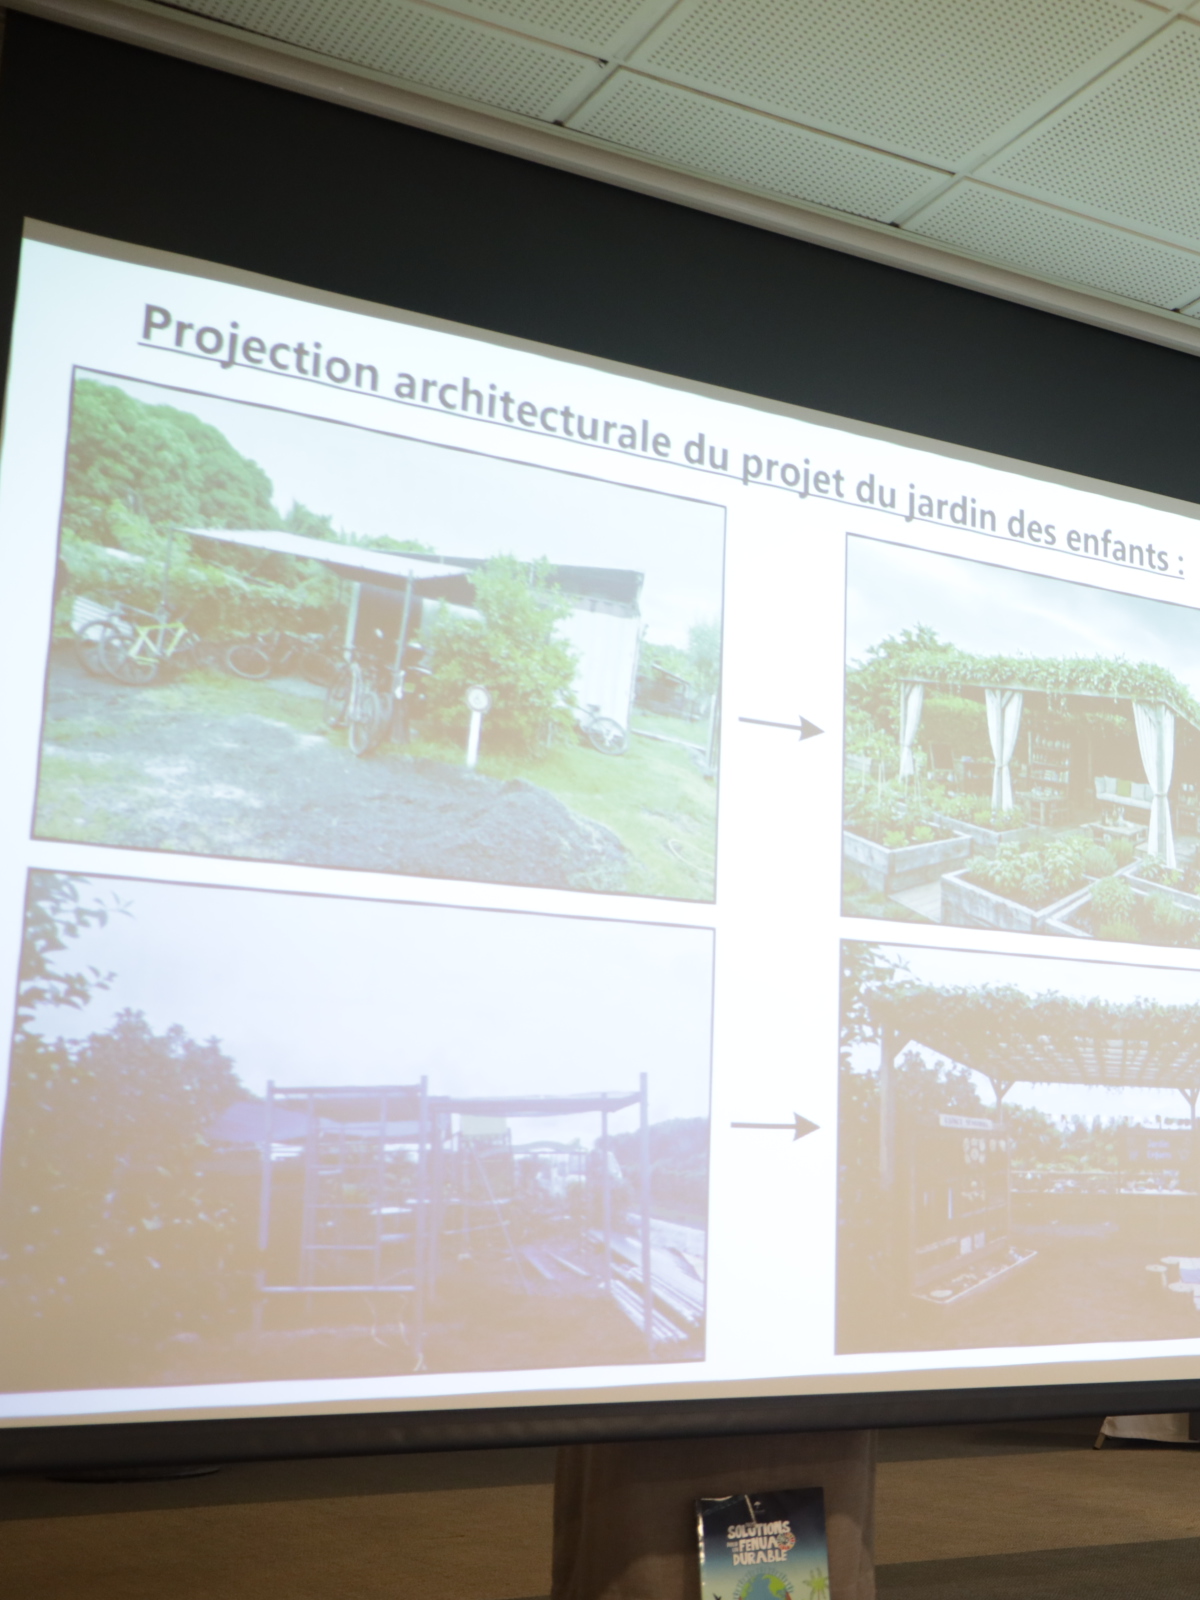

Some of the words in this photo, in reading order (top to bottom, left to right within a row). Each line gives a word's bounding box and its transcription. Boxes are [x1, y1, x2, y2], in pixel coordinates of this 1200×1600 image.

[142, 303, 379, 392] Projection
[394, 372, 672, 458] architecturale
[683, 432, 729, 471] du
[742, 452, 845, 499] projet
[856, 473, 896, 510] du
[904, 482, 997, 533] jardin
[1006, 508, 1057, 547] des
[1065, 528, 1170, 573] enfants
[727, 1520, 791, 1539] SOLUTIONS
[739, 1536, 778, 1551] FENUA
[733, 1549, 788, 1566] DURABLE
